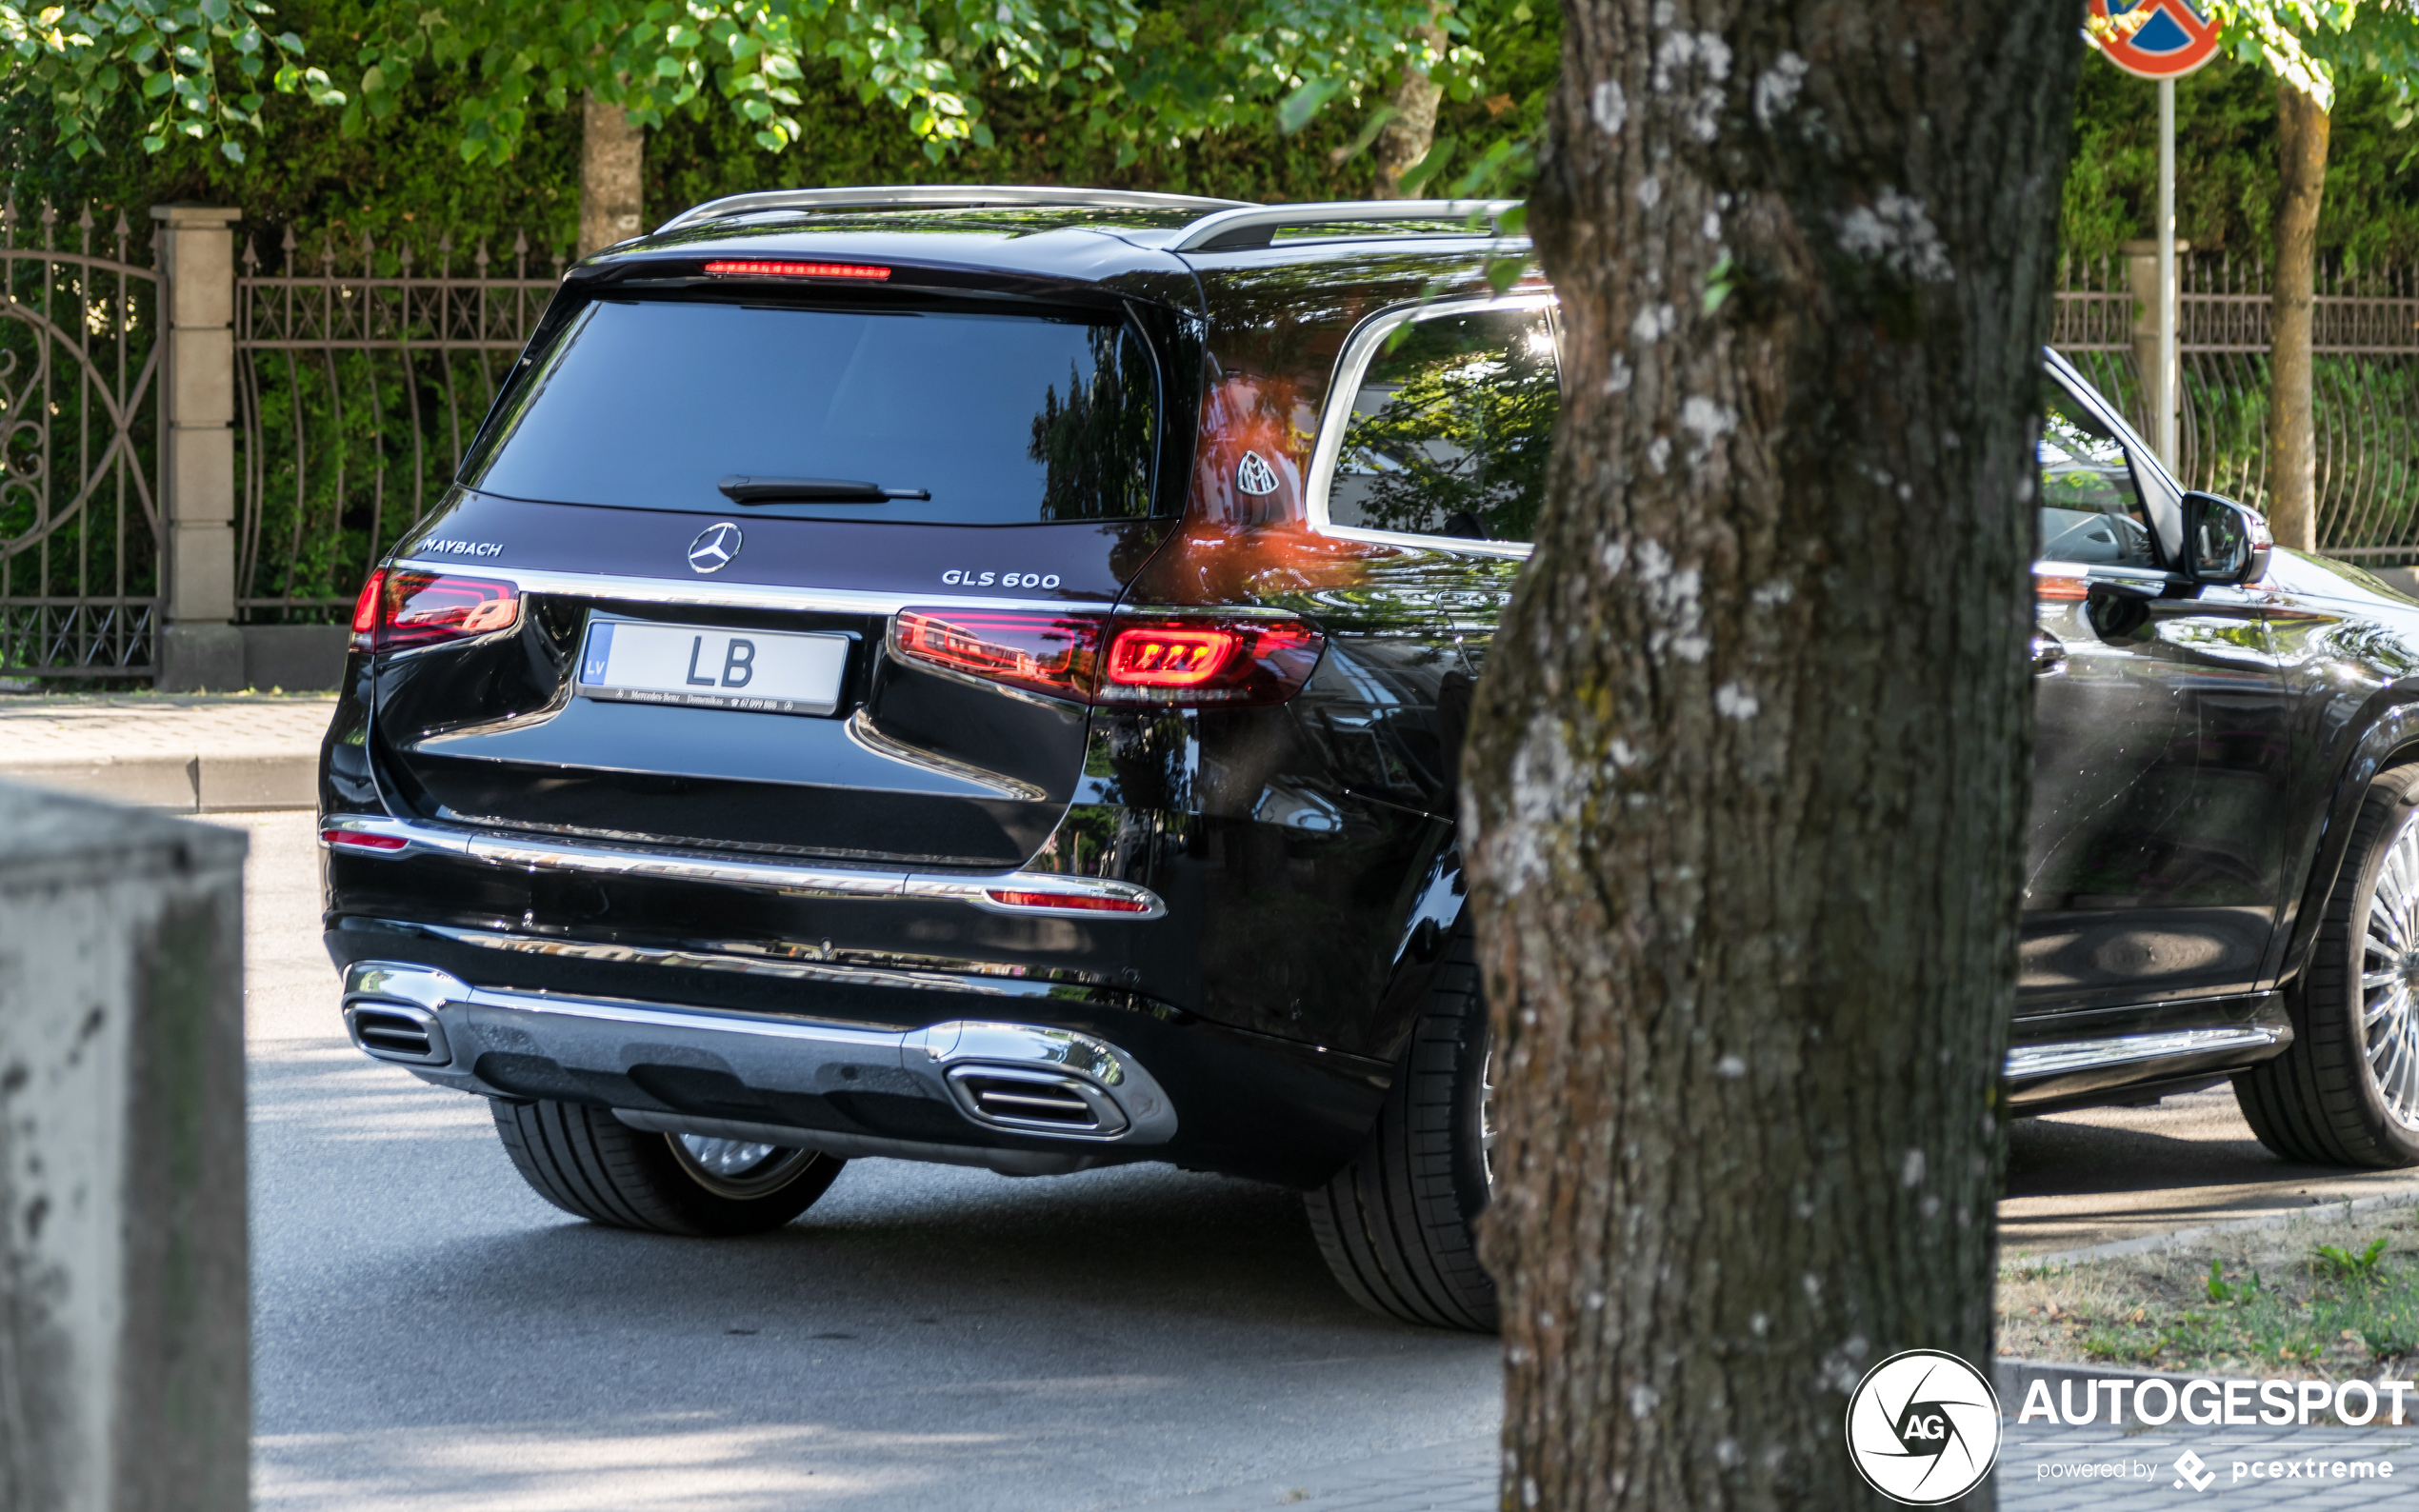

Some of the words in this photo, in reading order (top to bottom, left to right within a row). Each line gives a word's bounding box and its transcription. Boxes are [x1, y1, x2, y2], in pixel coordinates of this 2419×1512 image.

[422, 538, 505, 558] MAYBACH
[942, 569, 996, 587] GLS
[1002, 572, 1061, 589] 600
[586, 659, 606, 676] LV
[686, 635, 756, 688] LB
[630, 689, 681, 704] Mercedes-Benz
